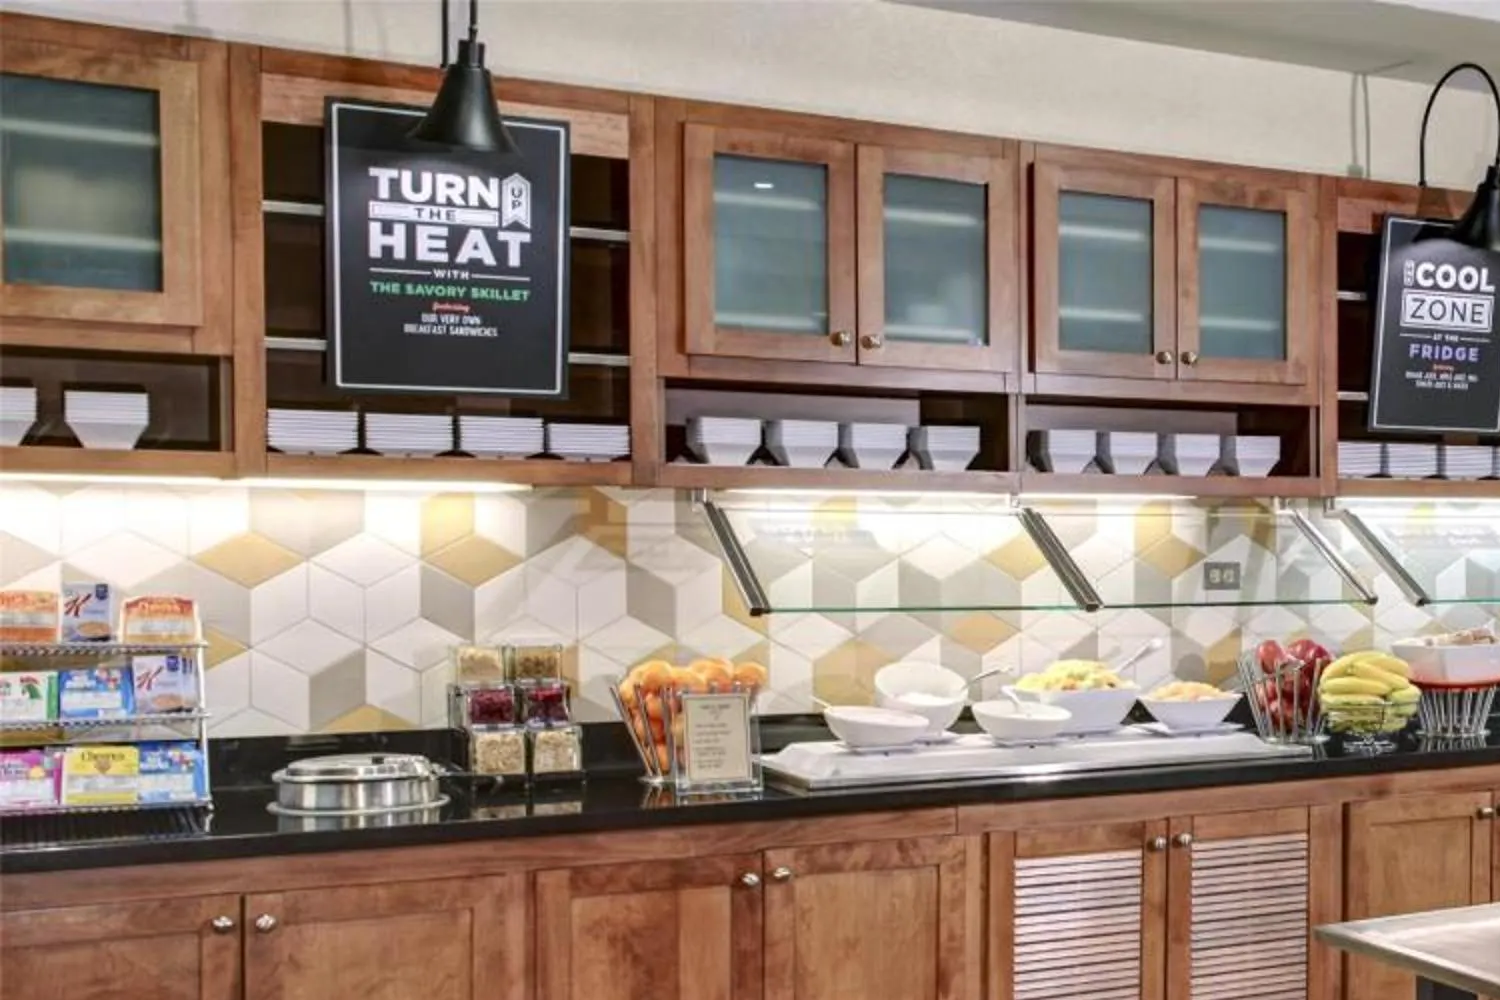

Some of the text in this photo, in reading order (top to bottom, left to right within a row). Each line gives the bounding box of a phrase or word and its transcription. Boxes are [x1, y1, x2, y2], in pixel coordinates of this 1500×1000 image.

[369, 167, 499, 208] TURN
[416, 207, 457, 223] THE
[369, 221, 531, 267] HEAT
[433, 269, 470, 280] WITH
[1416, 262, 1496, 292] COOL
[369, 281, 531, 301] THE SAVORY SKILLET
[1410, 298, 1485, 324] ZONE
[403, 323, 447, 335] BREAKFAST
[1409, 343, 1479, 362] FRIDGE
